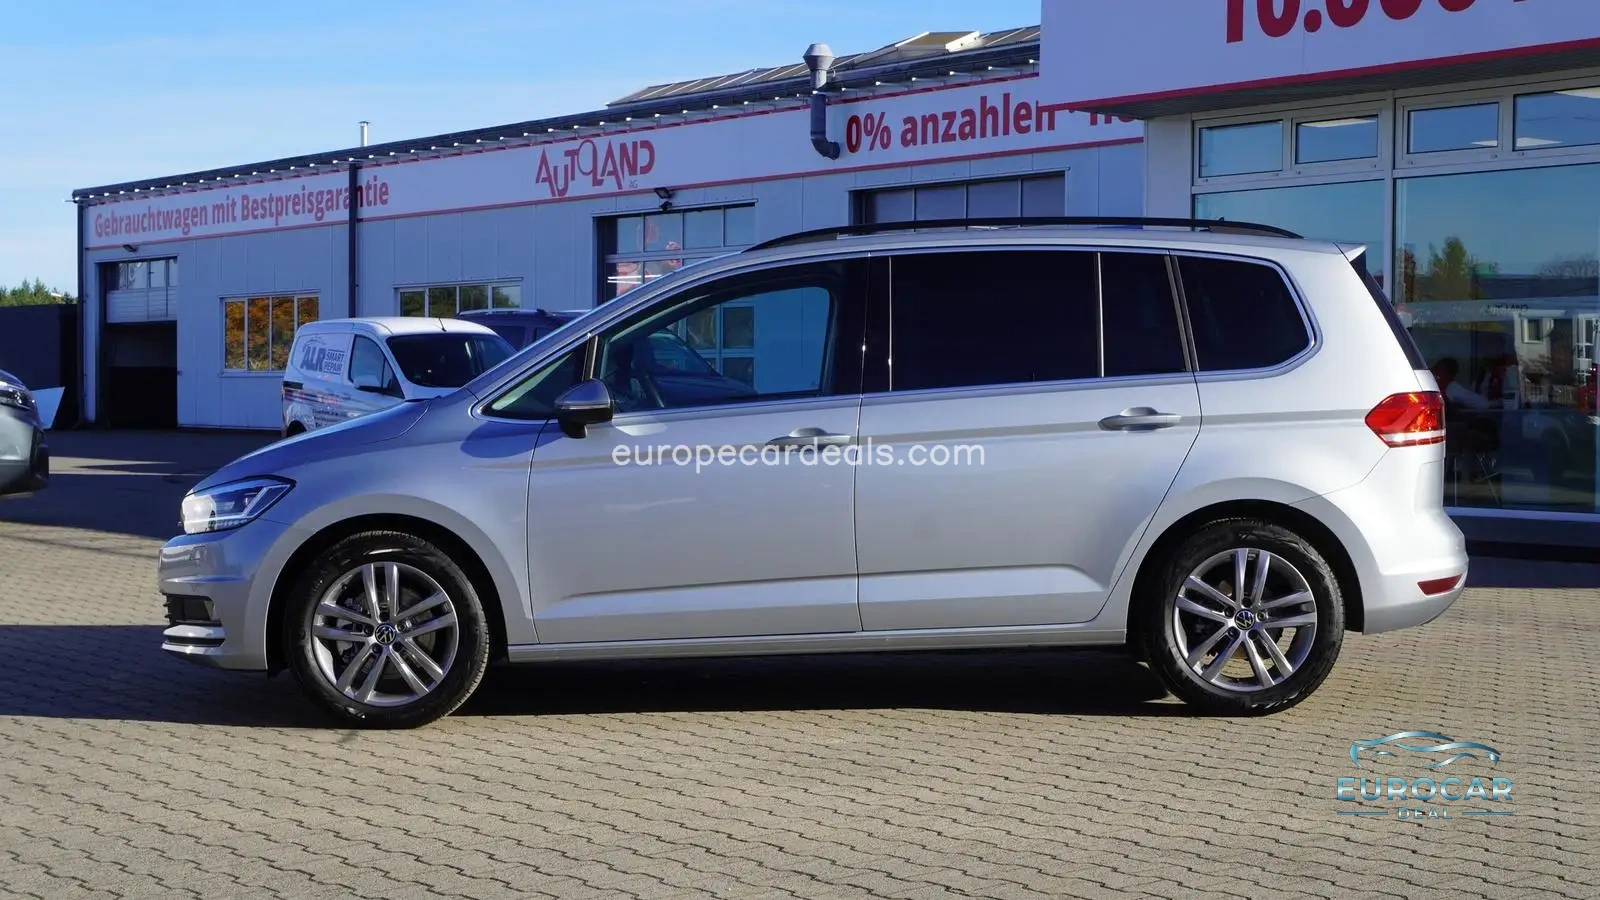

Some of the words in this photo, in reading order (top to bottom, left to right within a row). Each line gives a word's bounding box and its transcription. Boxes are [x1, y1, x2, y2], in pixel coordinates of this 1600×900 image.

[1226, 0, 1475, 43] 10.
[845, 111, 892, 153] 0%
[900, 92, 1056, 148] anzahlen
[535, 139, 656, 198] AUTOLAND
[94, 202, 208, 237] Gebrauchtwagen
[211, 194, 237, 225] mit
[241, 174, 389, 223] Bestpreisgarantie
